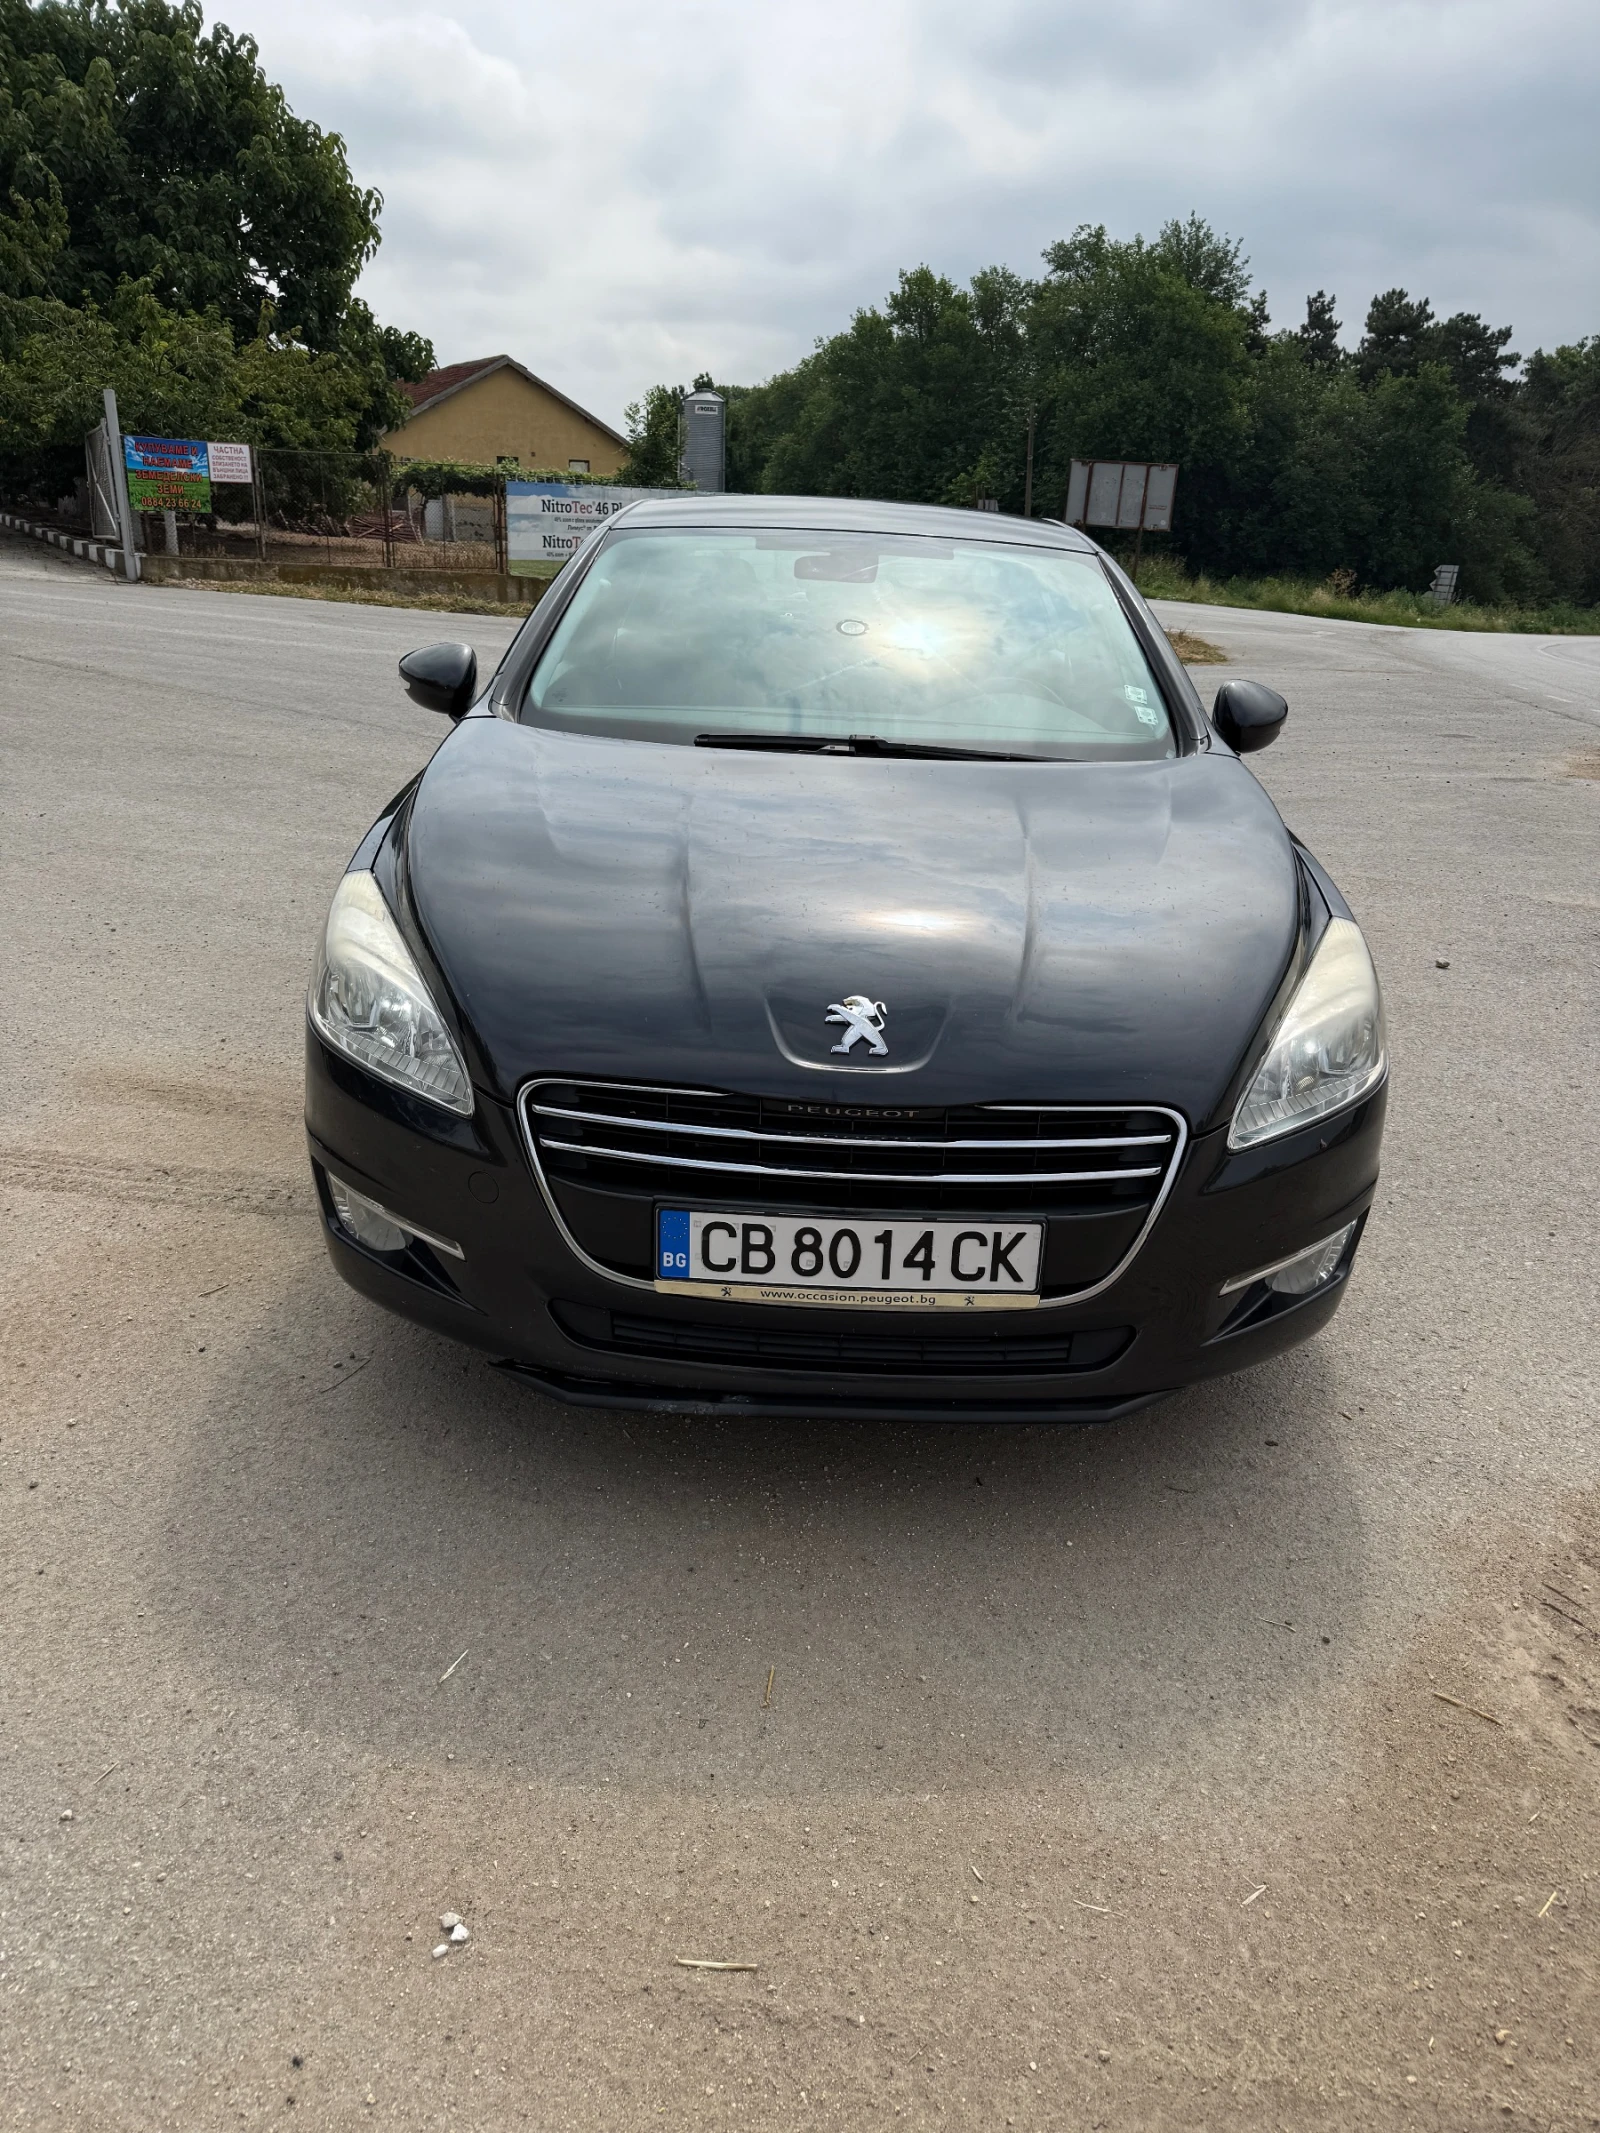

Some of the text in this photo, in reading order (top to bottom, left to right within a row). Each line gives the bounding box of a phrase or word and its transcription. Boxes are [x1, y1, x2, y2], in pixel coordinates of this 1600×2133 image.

[135, 442, 198, 456] КУПУВАМЕ И
[213, 446, 244, 455] ЧАСТНА
[143, 456, 193, 469] НАЕМАМЕ
[135, 469, 203, 482] ЗЕМЕДЕЛСКИ
[157, 484, 185, 494] ЗЕМИ
[141, 496, 202, 509] 0884 23 66 24
[595, 501, 609, 515] 46
[787, 1105, 920, 1118] PEUGEOT
[701, 1221, 1028, 1284] CB 8014 CK
[662, 1251, 687, 1268] BG
[760, 1289, 937, 1306] www.occasion.peugeot.bg
